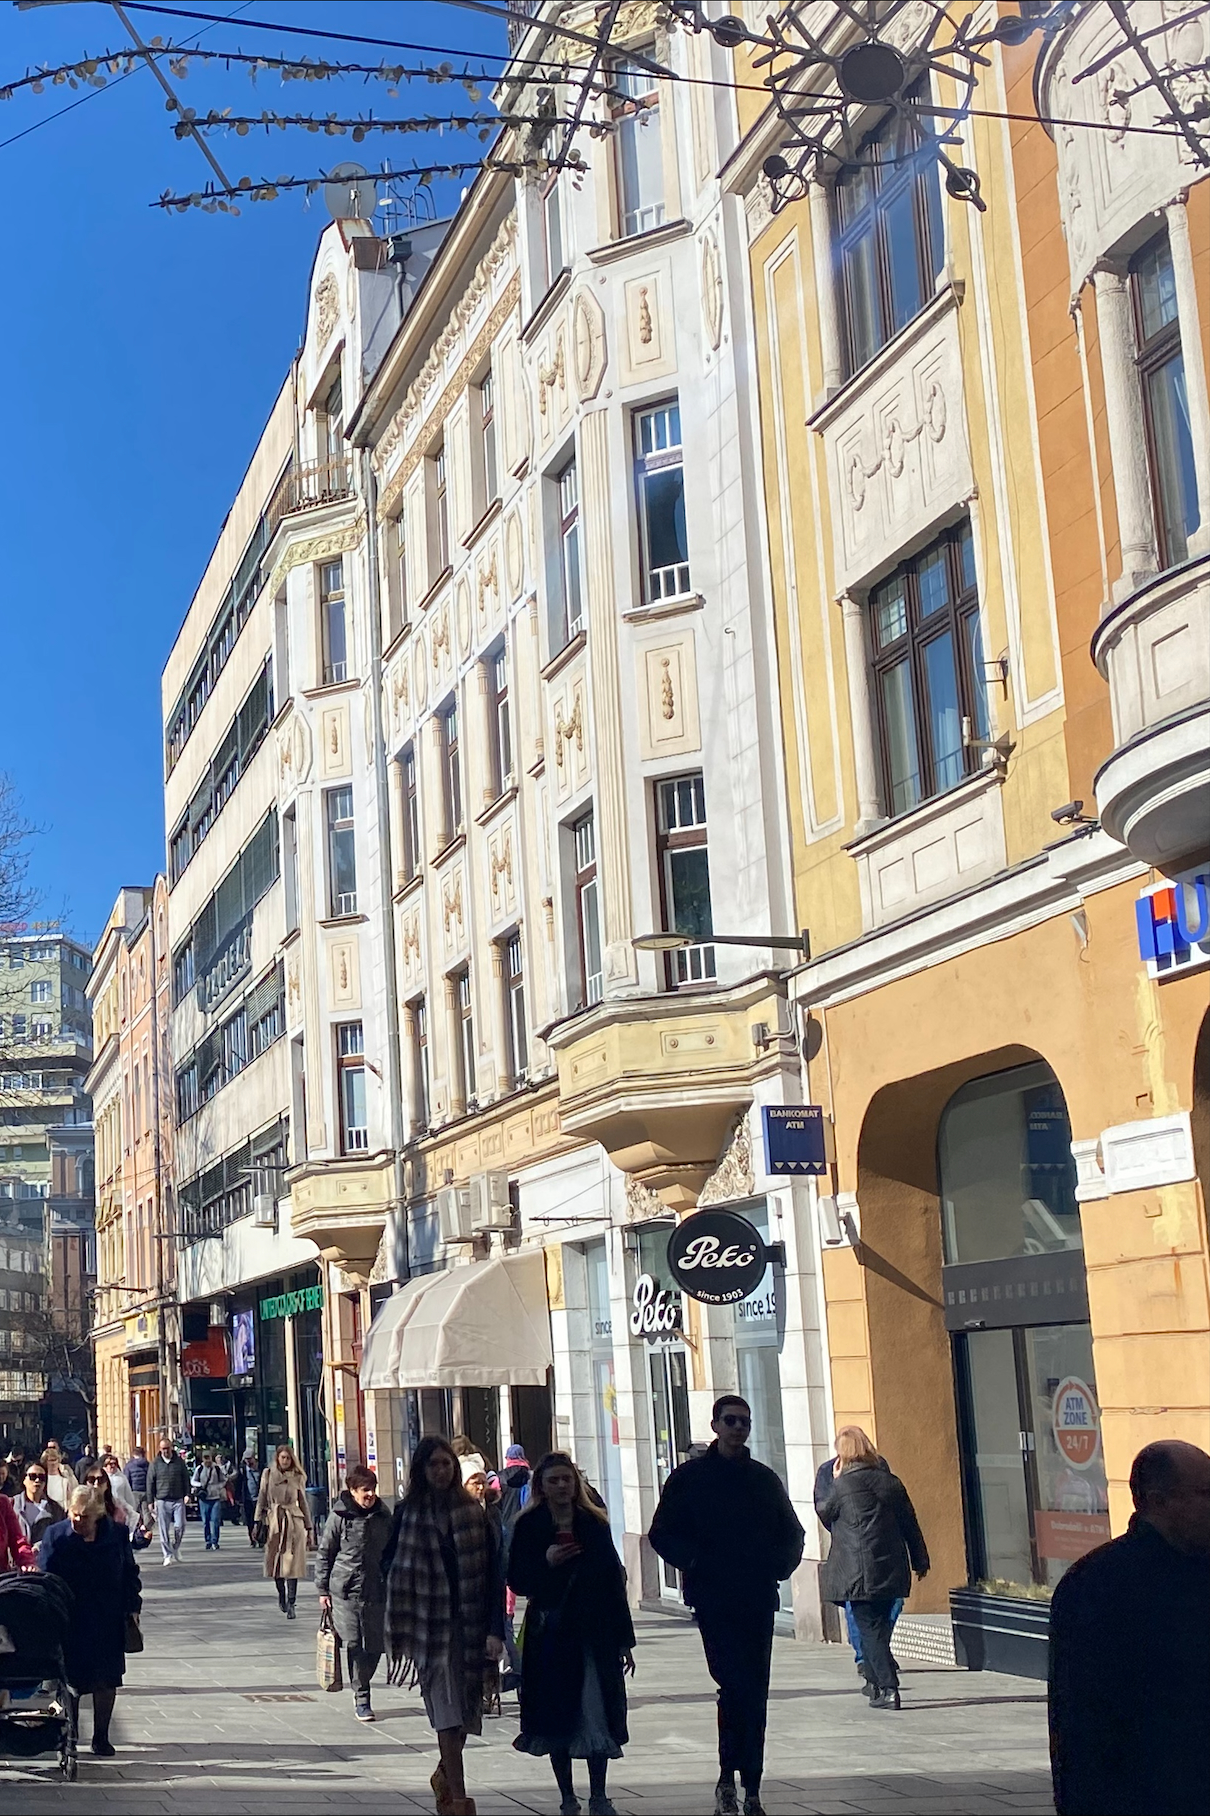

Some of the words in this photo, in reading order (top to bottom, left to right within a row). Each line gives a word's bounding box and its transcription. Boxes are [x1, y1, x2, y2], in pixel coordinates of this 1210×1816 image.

[769, 1109, 820, 1118] BANKOMAT
[785, 1120, 805, 1130] ATM
[677, 1235, 757, 1270] Peko
[696, 1289, 721, 1303] since
[722, 1288, 744, 1302] 1903
[630, 1273, 676, 1336] Peko
[738, 1298, 764, 1318] since
[1065, 1397, 1084, 1411] ATM
[1063, 1412, 1088, 1426] ZONE
[1066, 1435, 1089, 1451] 24/7
